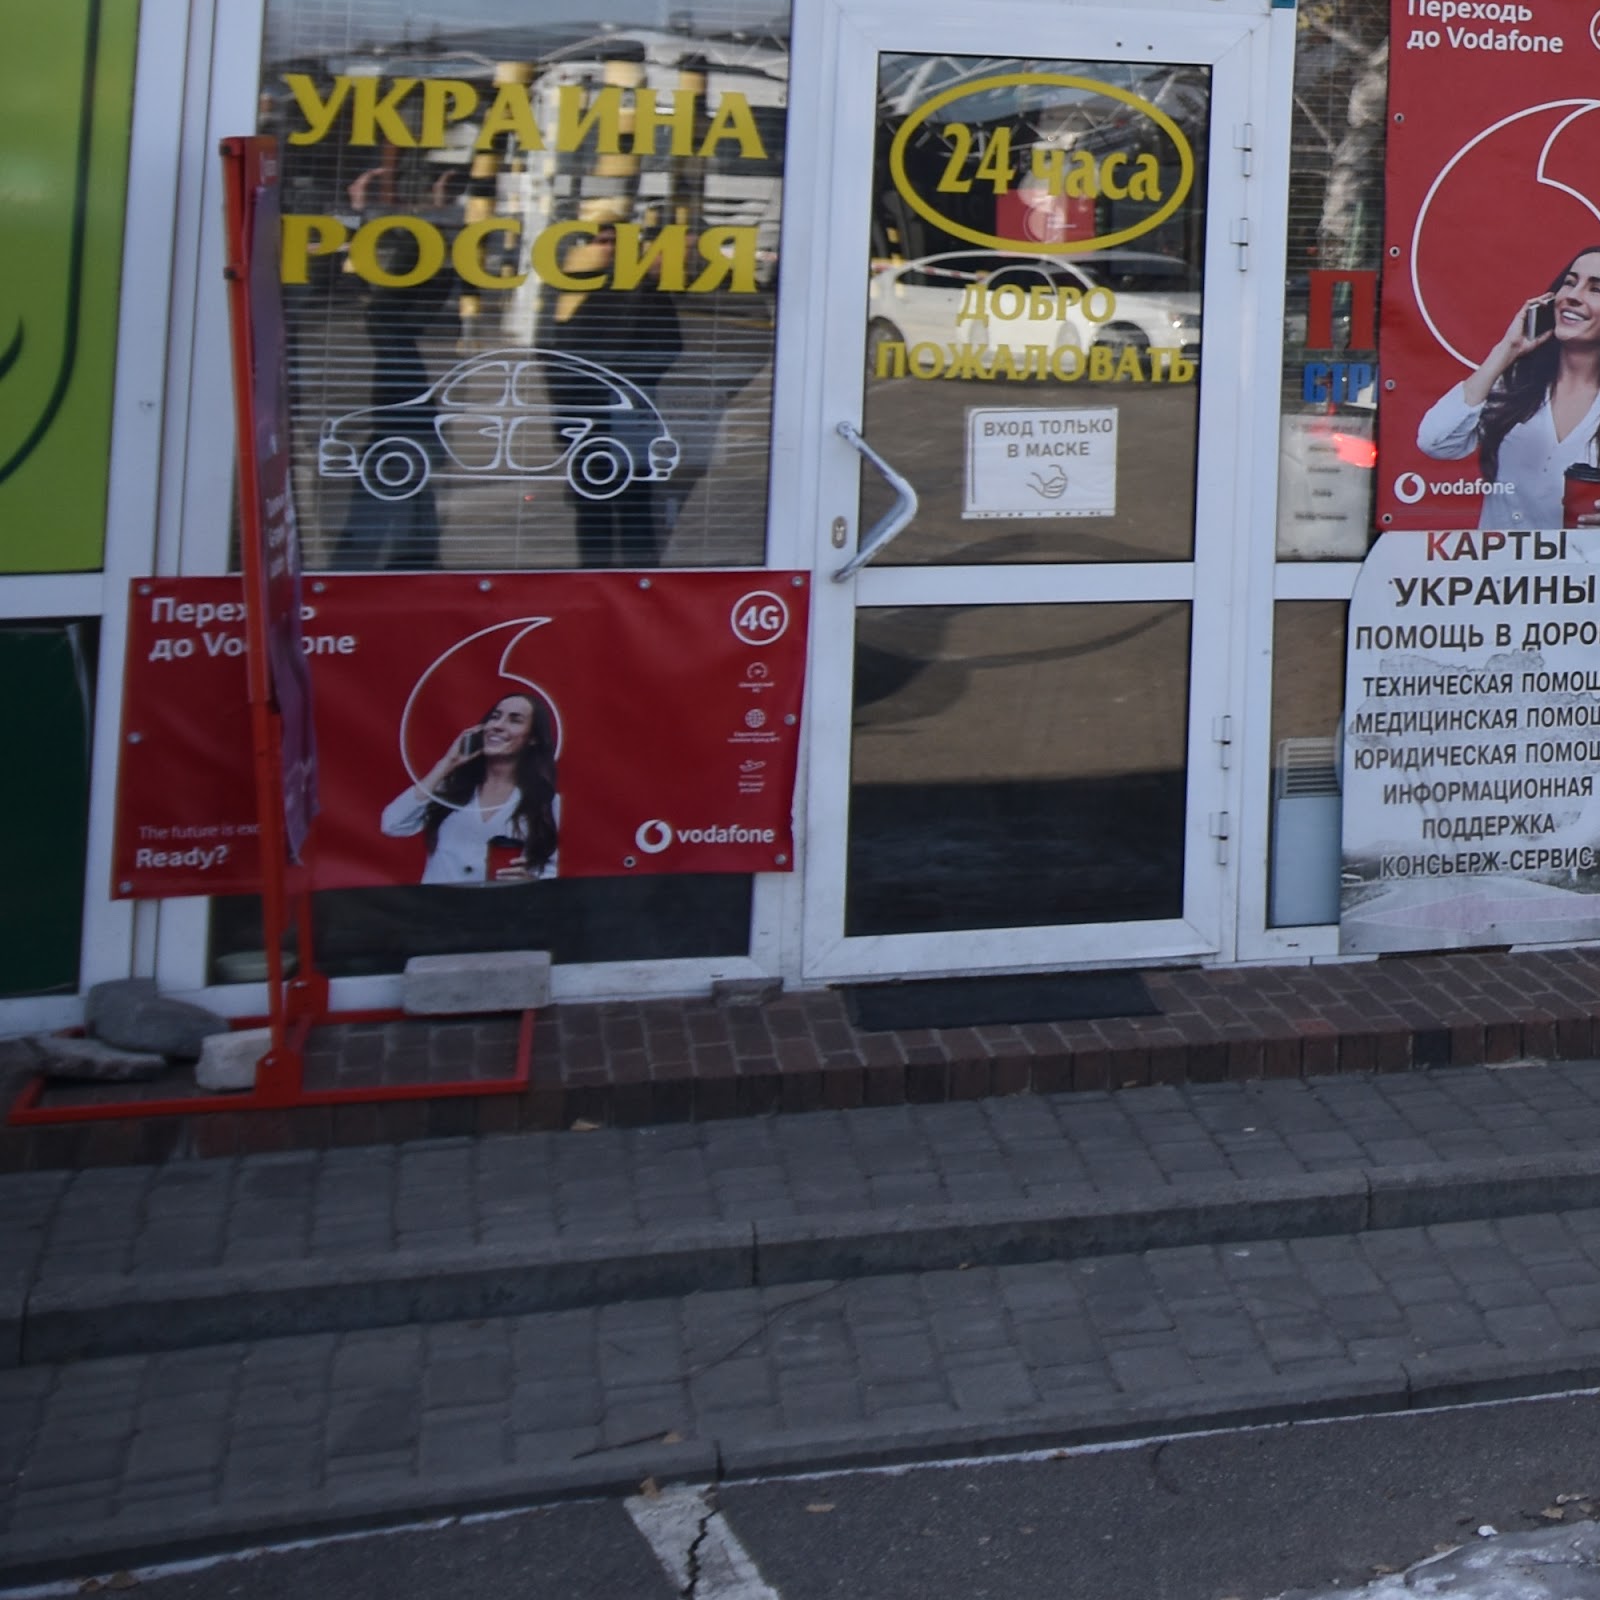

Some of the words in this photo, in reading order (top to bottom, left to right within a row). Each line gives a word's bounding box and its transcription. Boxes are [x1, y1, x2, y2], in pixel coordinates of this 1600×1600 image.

[1406, 30, 1441, 51] до
[1446, 26, 1564, 53] Vodafone
[282, 73, 768, 160] УКРАИНА
[936, 122, 1017, 195] 24
[1031, 147, 1163, 203] часа
[281, 212, 759, 295] РОССИЯ
[955, 283, 1117, 327] ДОБРО
[874, 340, 1197, 384] ПОЖАЛОВАТЬ
[983, 420, 1034, 440] ВХОД
[1039, 418, 1114, 436] ТОЛЬКО
[1006, 443, 1020, 458] В
[1025, 441, 1091, 458] МАСКЕ
[1429, 478, 1516, 496] vodafone
[1426, 530, 1567, 562] КАРТЫ
[1393, 574, 1597, 608] УКРАИНЫ
[739, 605, 780, 632] 4G
[148, 636, 195, 663] до
[1355, 622, 1485, 652] ПОМОЩЬ
[1495, 623, 1512, 646] В
[1362, 673, 1513, 698] ТЕХНИЧЕСКАЯ
[1355, 709, 1518, 737] МЕДИЦИНСКАЯ
[1353, 742, 1518, 773] ЮРИДИЧЕСКАЯ
[1383, 775, 1594, 805] ИНФОРМАЦИОННАЯ
[138, 825, 169, 840] The
[171, 823, 218, 839] future
[676, 824, 776, 845] vodafone
[1422, 812, 1556, 841] ПОДДЕРЖКА
[135, 844, 230, 870] Ready?
[1380, 845, 1595, 878] КОНСЬЕРЖ-СЕРВИС
